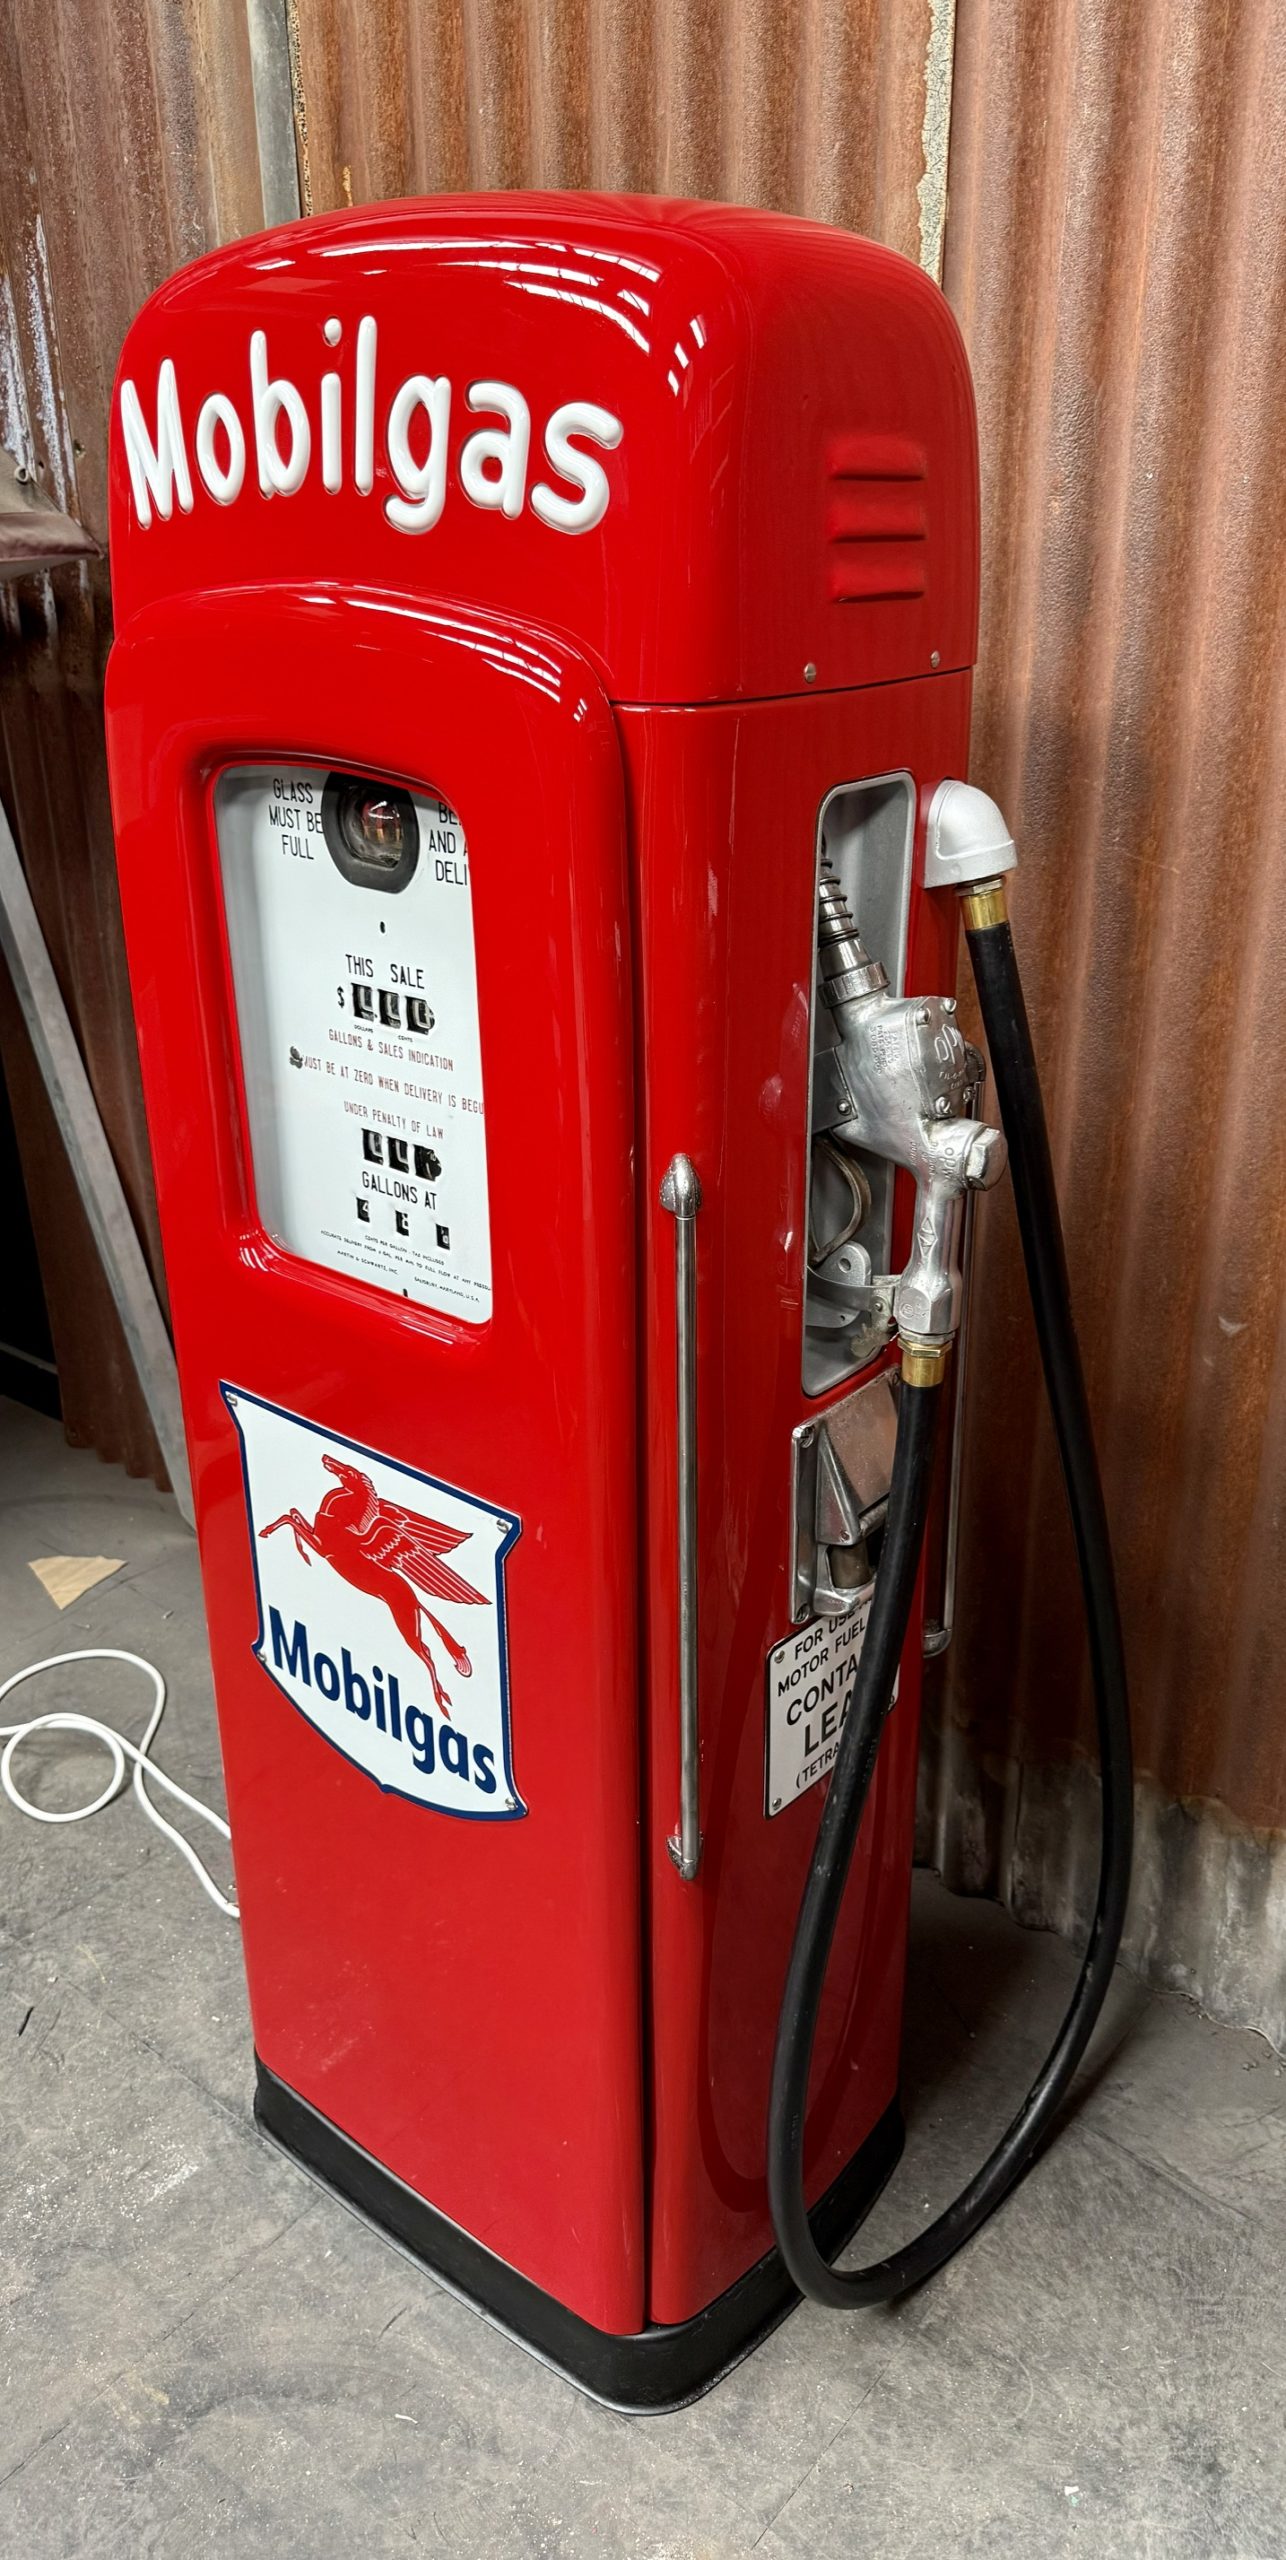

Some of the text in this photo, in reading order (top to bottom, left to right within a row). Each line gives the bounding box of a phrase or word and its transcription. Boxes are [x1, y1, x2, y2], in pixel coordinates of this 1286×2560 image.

[119, 314, 624, 535] Mobilgas
[273, 778, 313, 804] GLASS
[268, 804, 324, 834] MUST BE
[281, 834, 314, 860] FULL
[429, 829, 456, 854] AND
[345, 953, 425, 990] THIS SALE
[328, 1028, 454, 1072] GALLONS & SALES INDICATION
[326, 1062, 335, 1076] BE
[340, 1065, 349, 1079] AT
[354, 1069, 374, 1086] ZERO
[378, 1076, 400, 1093] WHEN
[404, 1083, 443, 1105] DELIVERY
[448, 1094, 456, 1108] IS
[344, 1100, 444, 1139] UNDER PENALTY OF LAW
[361, 1171, 437, 1210] GALLONS AT
[777, 1617, 866, 1697] MOTOR FUEL
[795, 1627, 823, 1660] FOR
[268, 1604, 498, 1795] Mobilgas
[787, 1653, 858, 1726] CONTA
